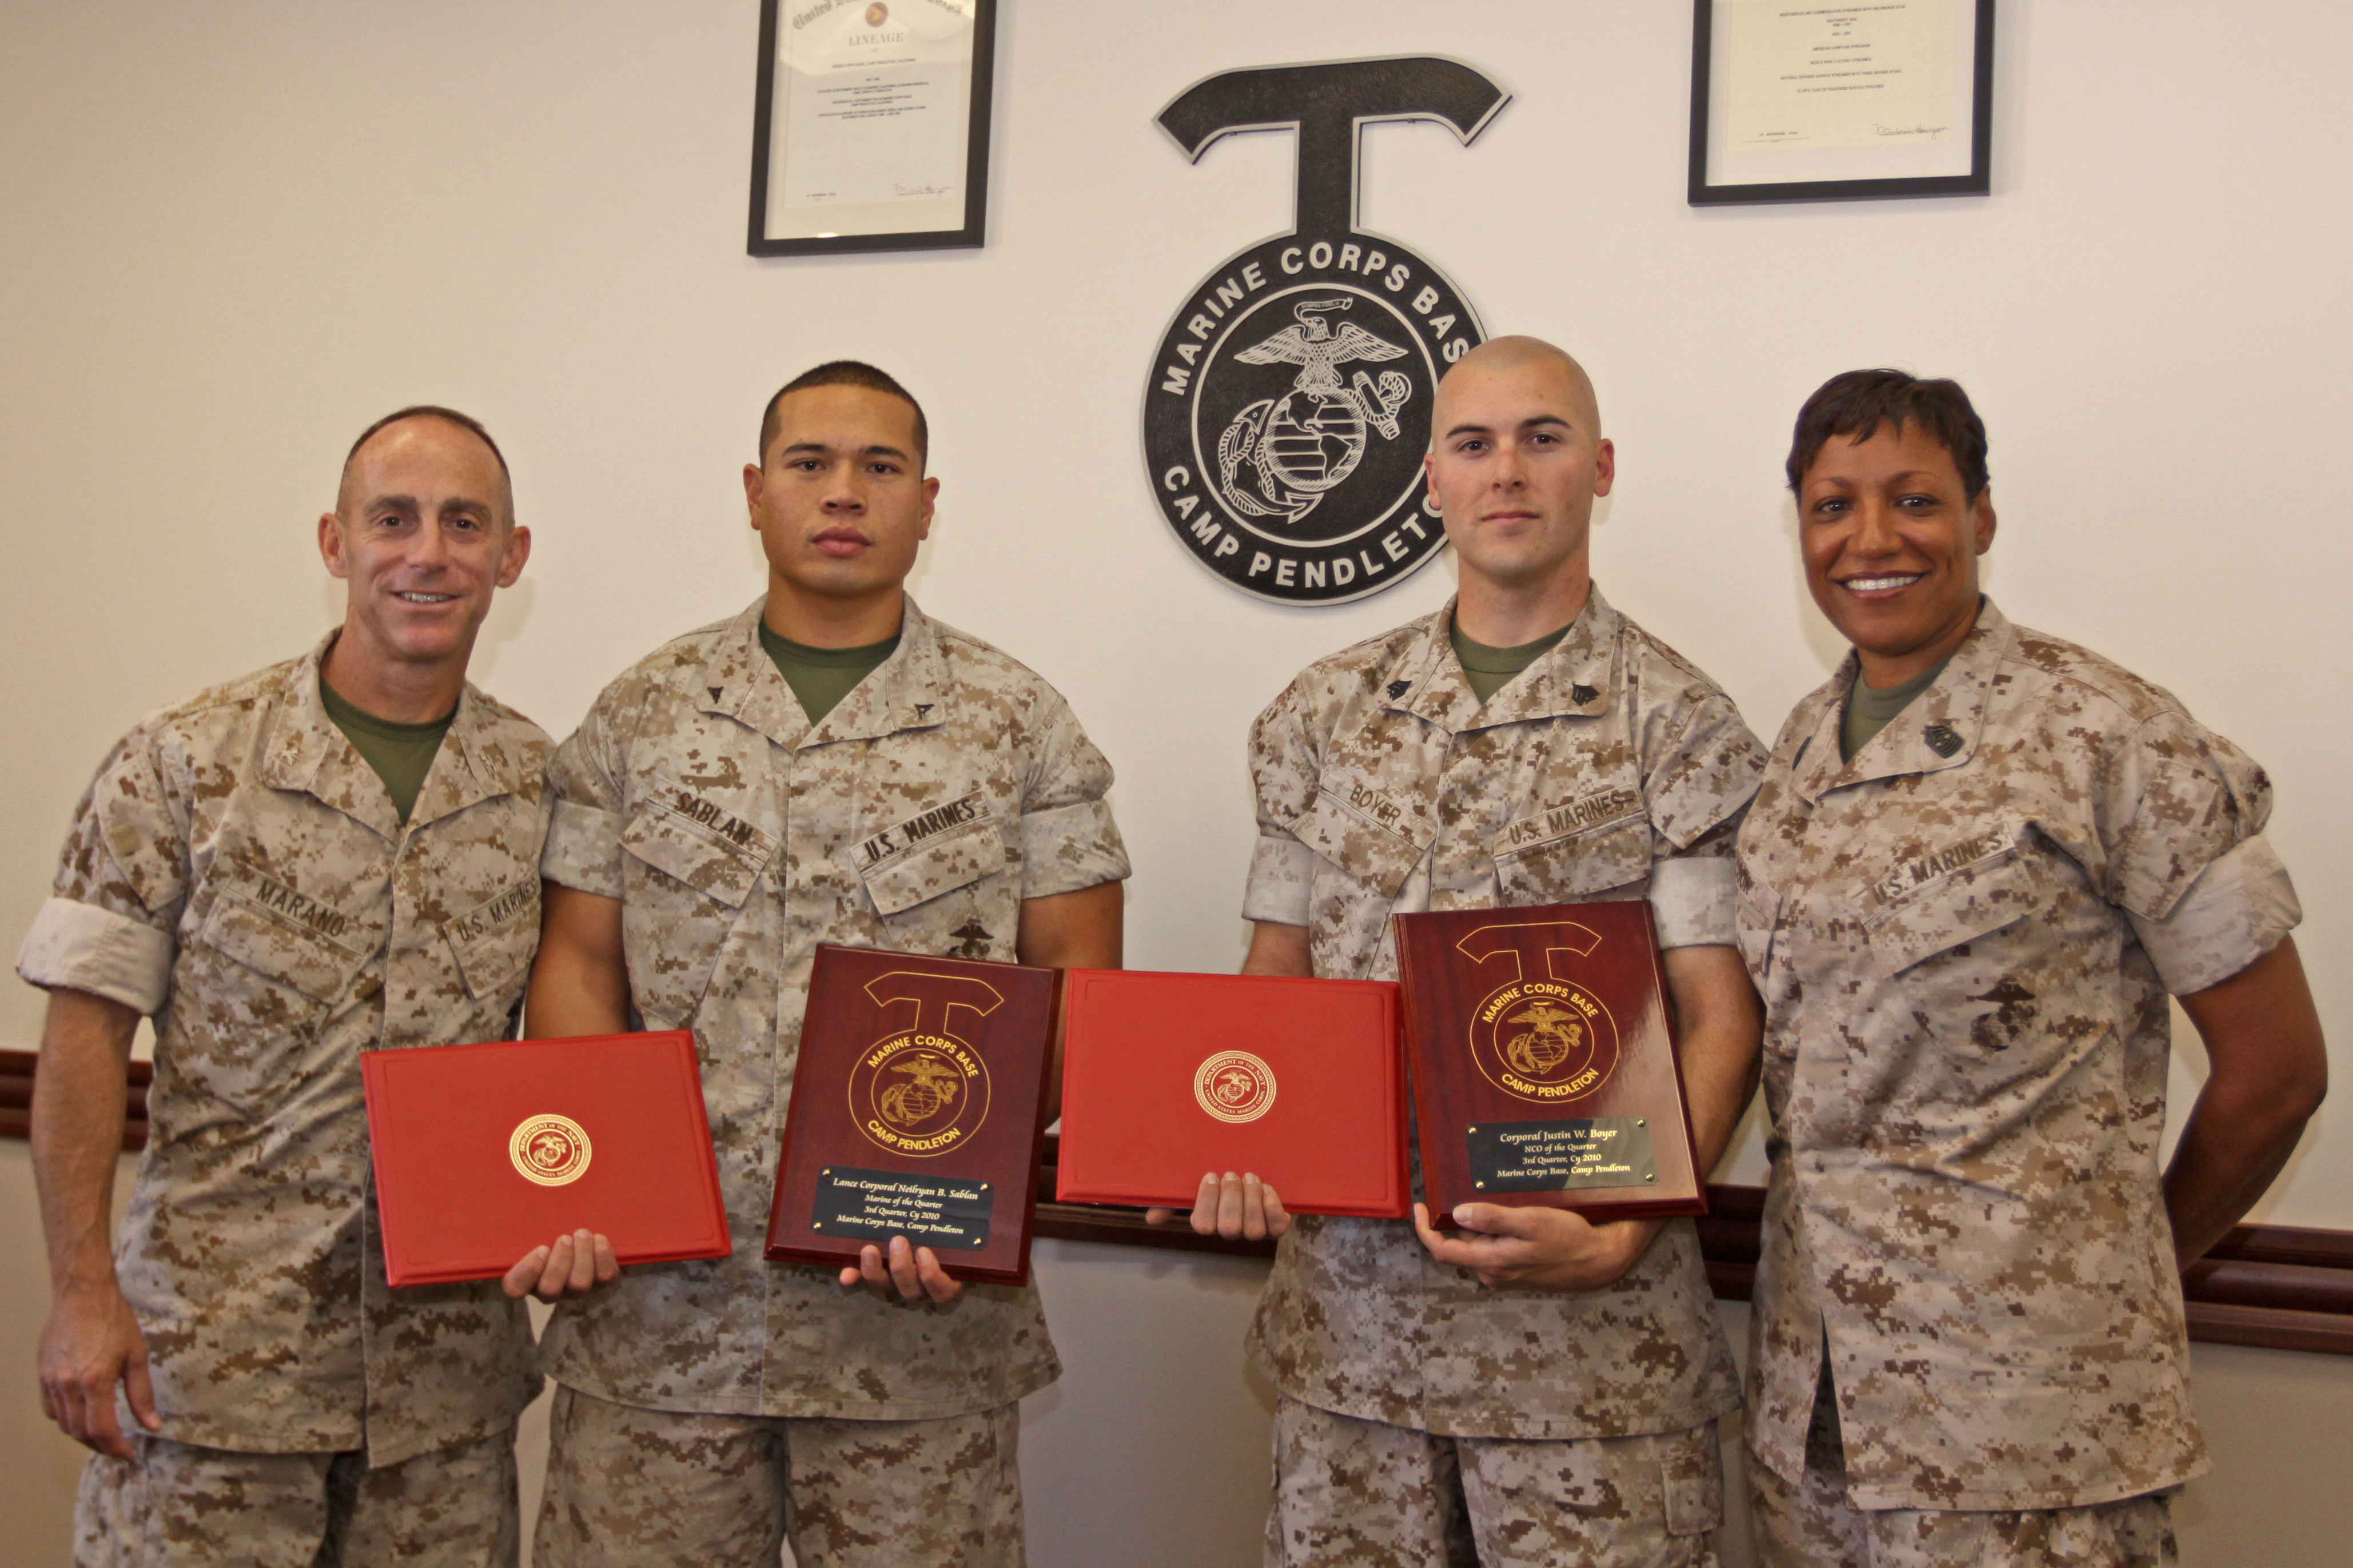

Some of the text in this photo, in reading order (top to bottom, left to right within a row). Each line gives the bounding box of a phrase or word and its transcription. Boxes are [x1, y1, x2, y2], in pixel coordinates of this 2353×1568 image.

[849, 32, 903, 46] LINEAGE
[1161, 241, 1470, 396] MARINE CORPS BAS
[1164, 465, 1240, 558] CAMP
[674, 792, 754, 847] SABLAN
[1349, 784, 1402, 827] BOYER
[1508, 789, 1625, 845] U.S. MARINES
[863, 797, 977, 863] U.S. MARINES
[1871, 829, 2002, 907] U.S. MARINES
[255, 880, 346, 937] MARANO
[456, 877, 538, 943] U.S. MARINES
[1482, 983, 1599, 1023] MARINE CORPS BASE
[867, 1035, 979, 1077] MARINE CORPS BASE
[1204, 1059, 1237, 1085] DEPARTMENT
[1245, 1062, 1255, 1070] THE
[1255, 1070, 1266, 1087] NAVY
[1502, 1067, 1599, 1097] CAMP PENDLETON
[1205, 1088, 1265, 1114] UNITED STATES MARINE CORPS
[519, 1123, 548, 1151] DEPARTMENT
[868, 1120, 961, 1150] CAMP PENDLETON
[1500, 1128, 1618, 1145] Corporal Justin W. Boyer
[1524, 1143, 1597, 1155] NCO of the Quarter
[1497, 1163, 1631, 1178] Marine Corps Base, Camp Pendleton
[1523, 1154, 1602, 1165] 3rd Quarter, Cy 2010
[833, 1178, 978, 1200] Lance Corporal Neilryan B. Sablan
[865, 1194, 942, 1208] Marine of the Quarter
[837, 1214, 965, 1234] Marine Corps Base, Camp Pendleton
[878, 1207, 907, 1217] Quarter,
[909, 1210, 920, 1220] Cy
[921, 1212, 940, 1220] 2010
